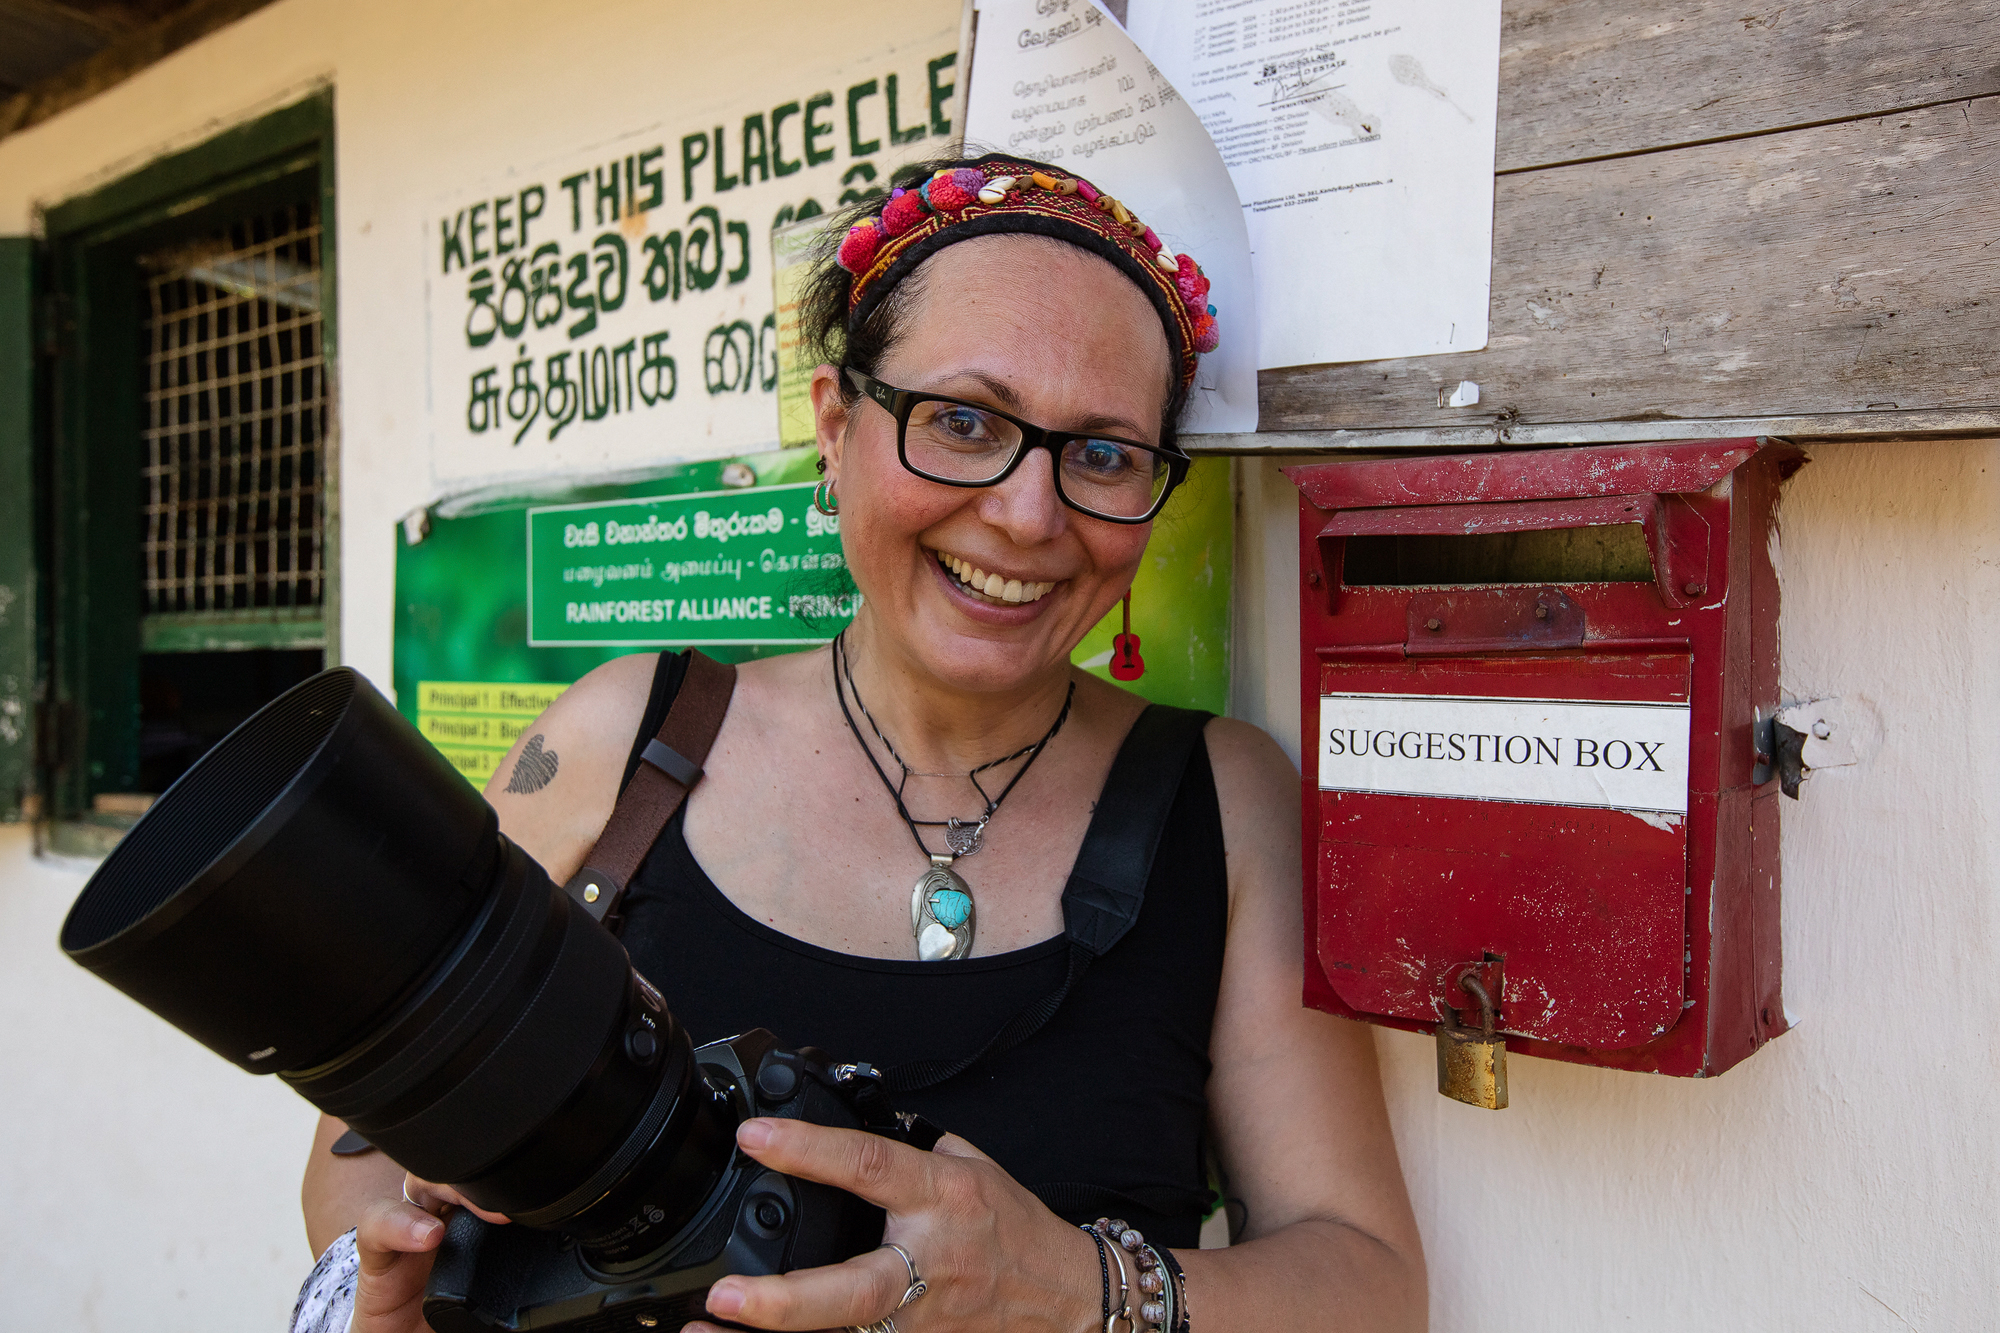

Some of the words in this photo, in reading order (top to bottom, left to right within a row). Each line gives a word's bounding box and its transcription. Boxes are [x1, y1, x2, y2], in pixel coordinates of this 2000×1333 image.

[1346, 15, 1370, 25] Division
[1313, 60, 1346, 73] ESTATE
[1285, 121, 1308, 129] Division
[1287, 111, 1309, 120] Division
[1281, 140, 1303, 148] Division
[1283, 130, 1306, 139] Division
[1299, 146, 1317, 155] Please
[1318, 141, 1337, 150] inform
[1339, 138, 1357, 147] Union
[1359, 133, 1381, 142] leaders
[441, 184, 546, 274] KEEP
[562, 145, 665, 232] THIS
[681, 91, 835, 202] PLACE
[641, 205, 750, 302] තබා
[468, 331, 678, 446] சுத்தமாக
[563, 557, 653, 588] மழைவனம்
[660, 553, 742, 584] அமைப்பு
[566, 599, 675, 623] RAINFOREST
[678, 596, 772, 621] ALLIANCE
[429, 689, 478, 709] Principal
[429, 719, 478, 739] Principal
[483, 721, 490, 738] 2
[1329, 728, 1562, 766] SUGGESTION
[1574, 738, 1665, 772] BOX
